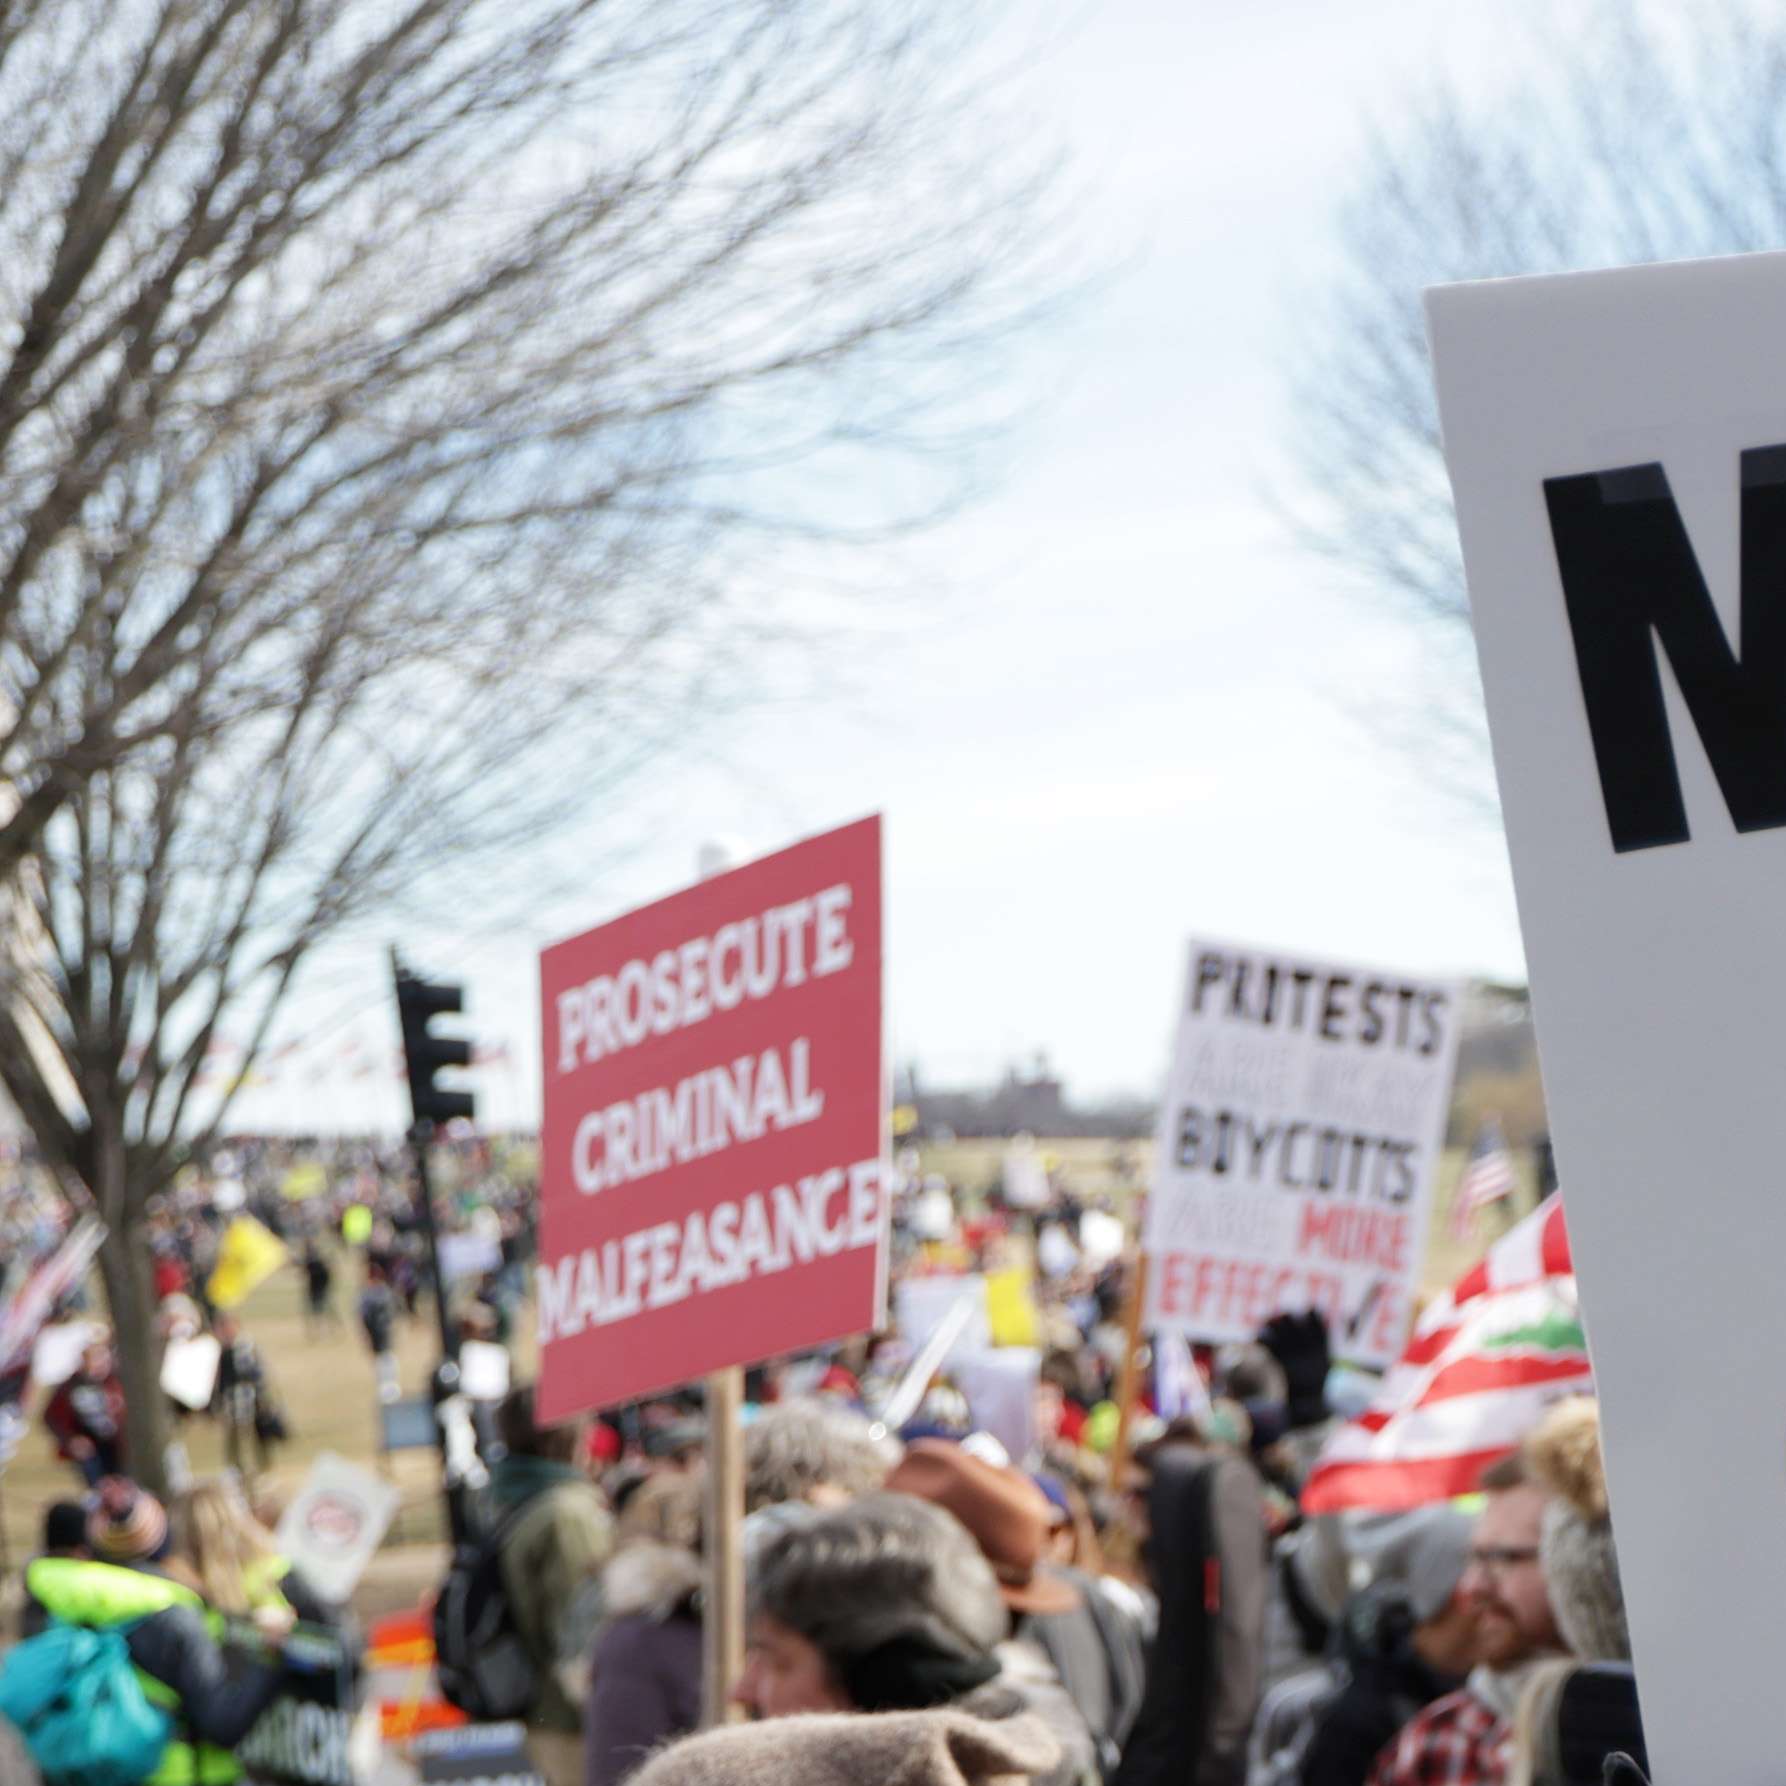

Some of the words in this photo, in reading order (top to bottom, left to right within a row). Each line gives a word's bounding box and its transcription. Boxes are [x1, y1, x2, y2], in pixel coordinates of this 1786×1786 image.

[556, 883, 854, 1074] PROSECUTE
[1190, 951, 1450, 1056] PROTESTS
[571, 1037, 825, 1195] CRIMINAL
[1175, 1105, 1423, 1204] BOYCOTTS
[536, 1157, 888, 1346] MALFEASANCE
[1296, 1202, 1413, 1273] MORE
